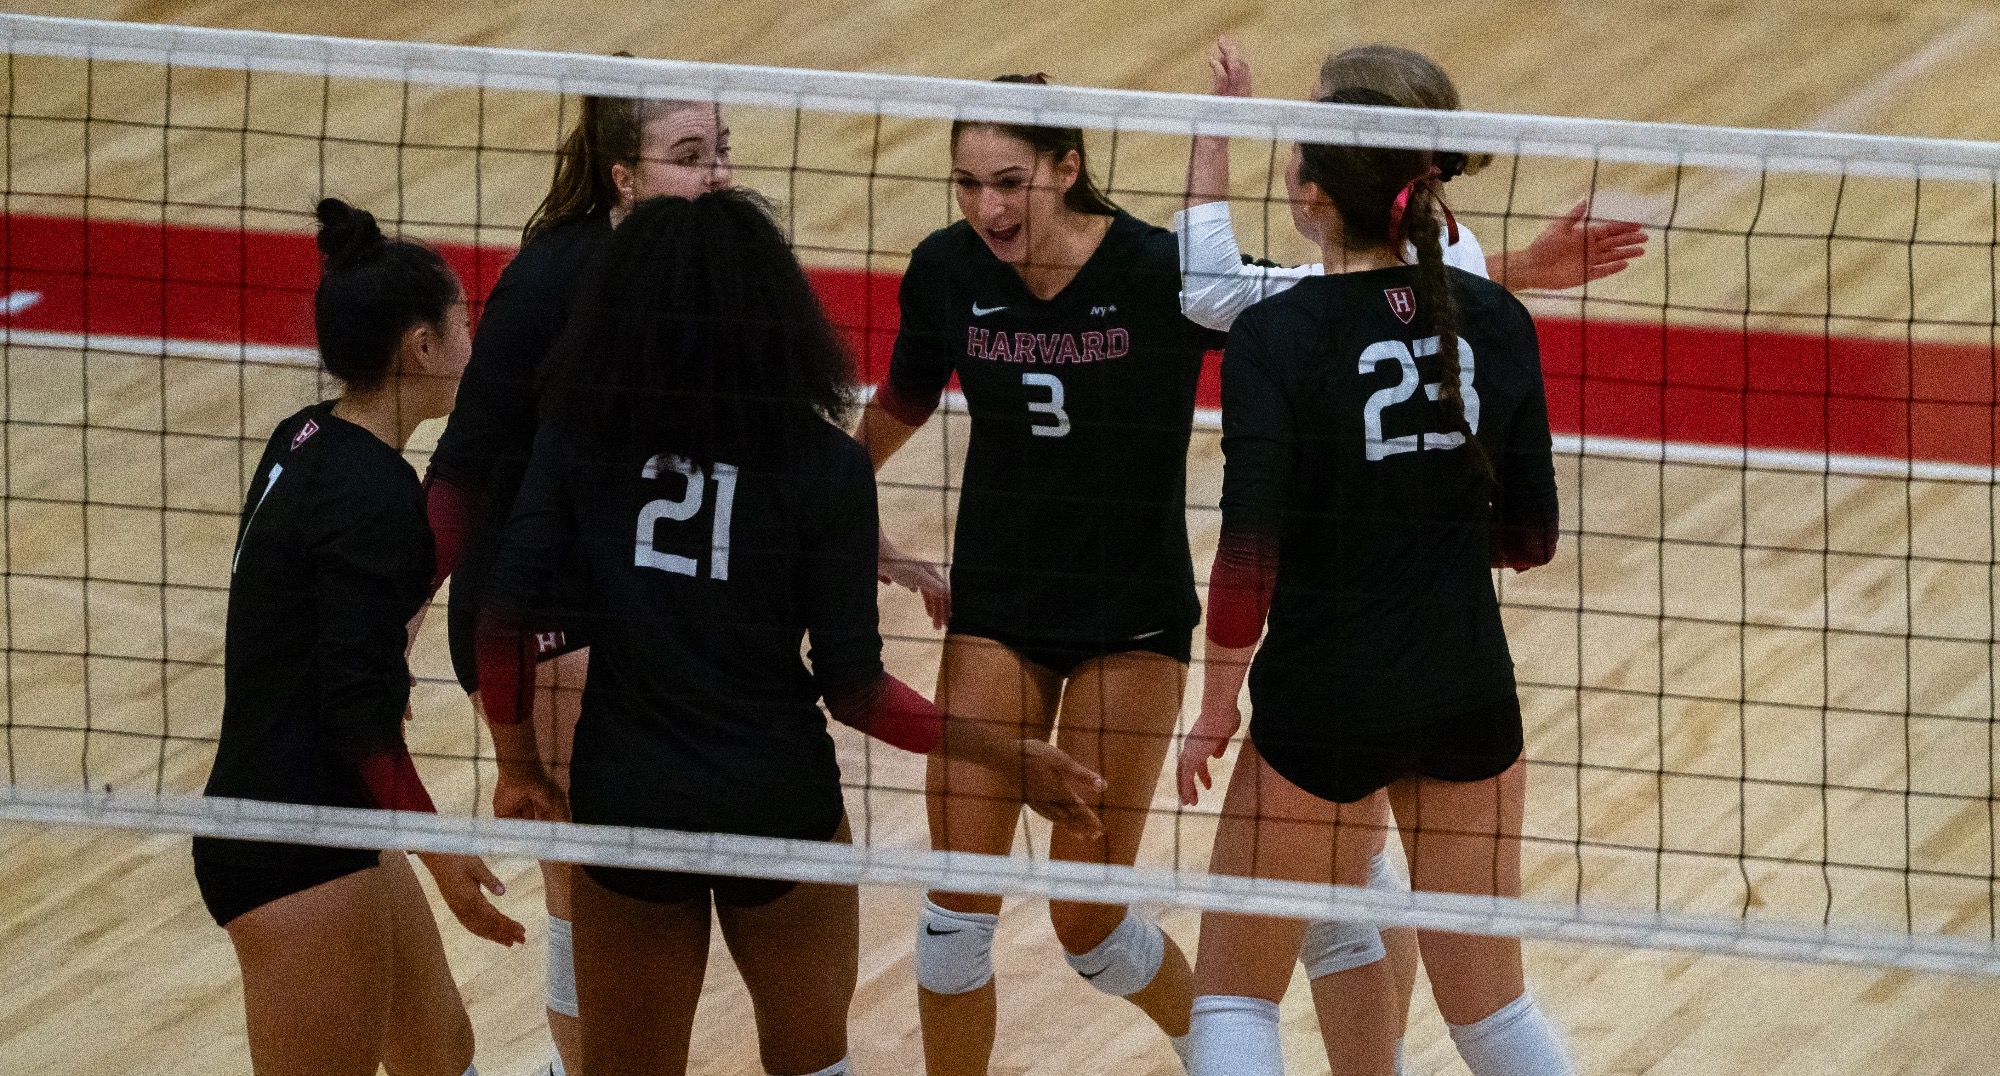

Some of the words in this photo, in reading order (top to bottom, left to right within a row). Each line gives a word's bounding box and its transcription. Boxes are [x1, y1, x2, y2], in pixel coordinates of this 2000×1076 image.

[1392, 292, 1411, 313] H
[967, 326, 1129, 363] HARVARD
[1022, 373, 1071, 437] 3
[1358, 335, 1480, 461] 23
[634, 453, 739, 581] 21
